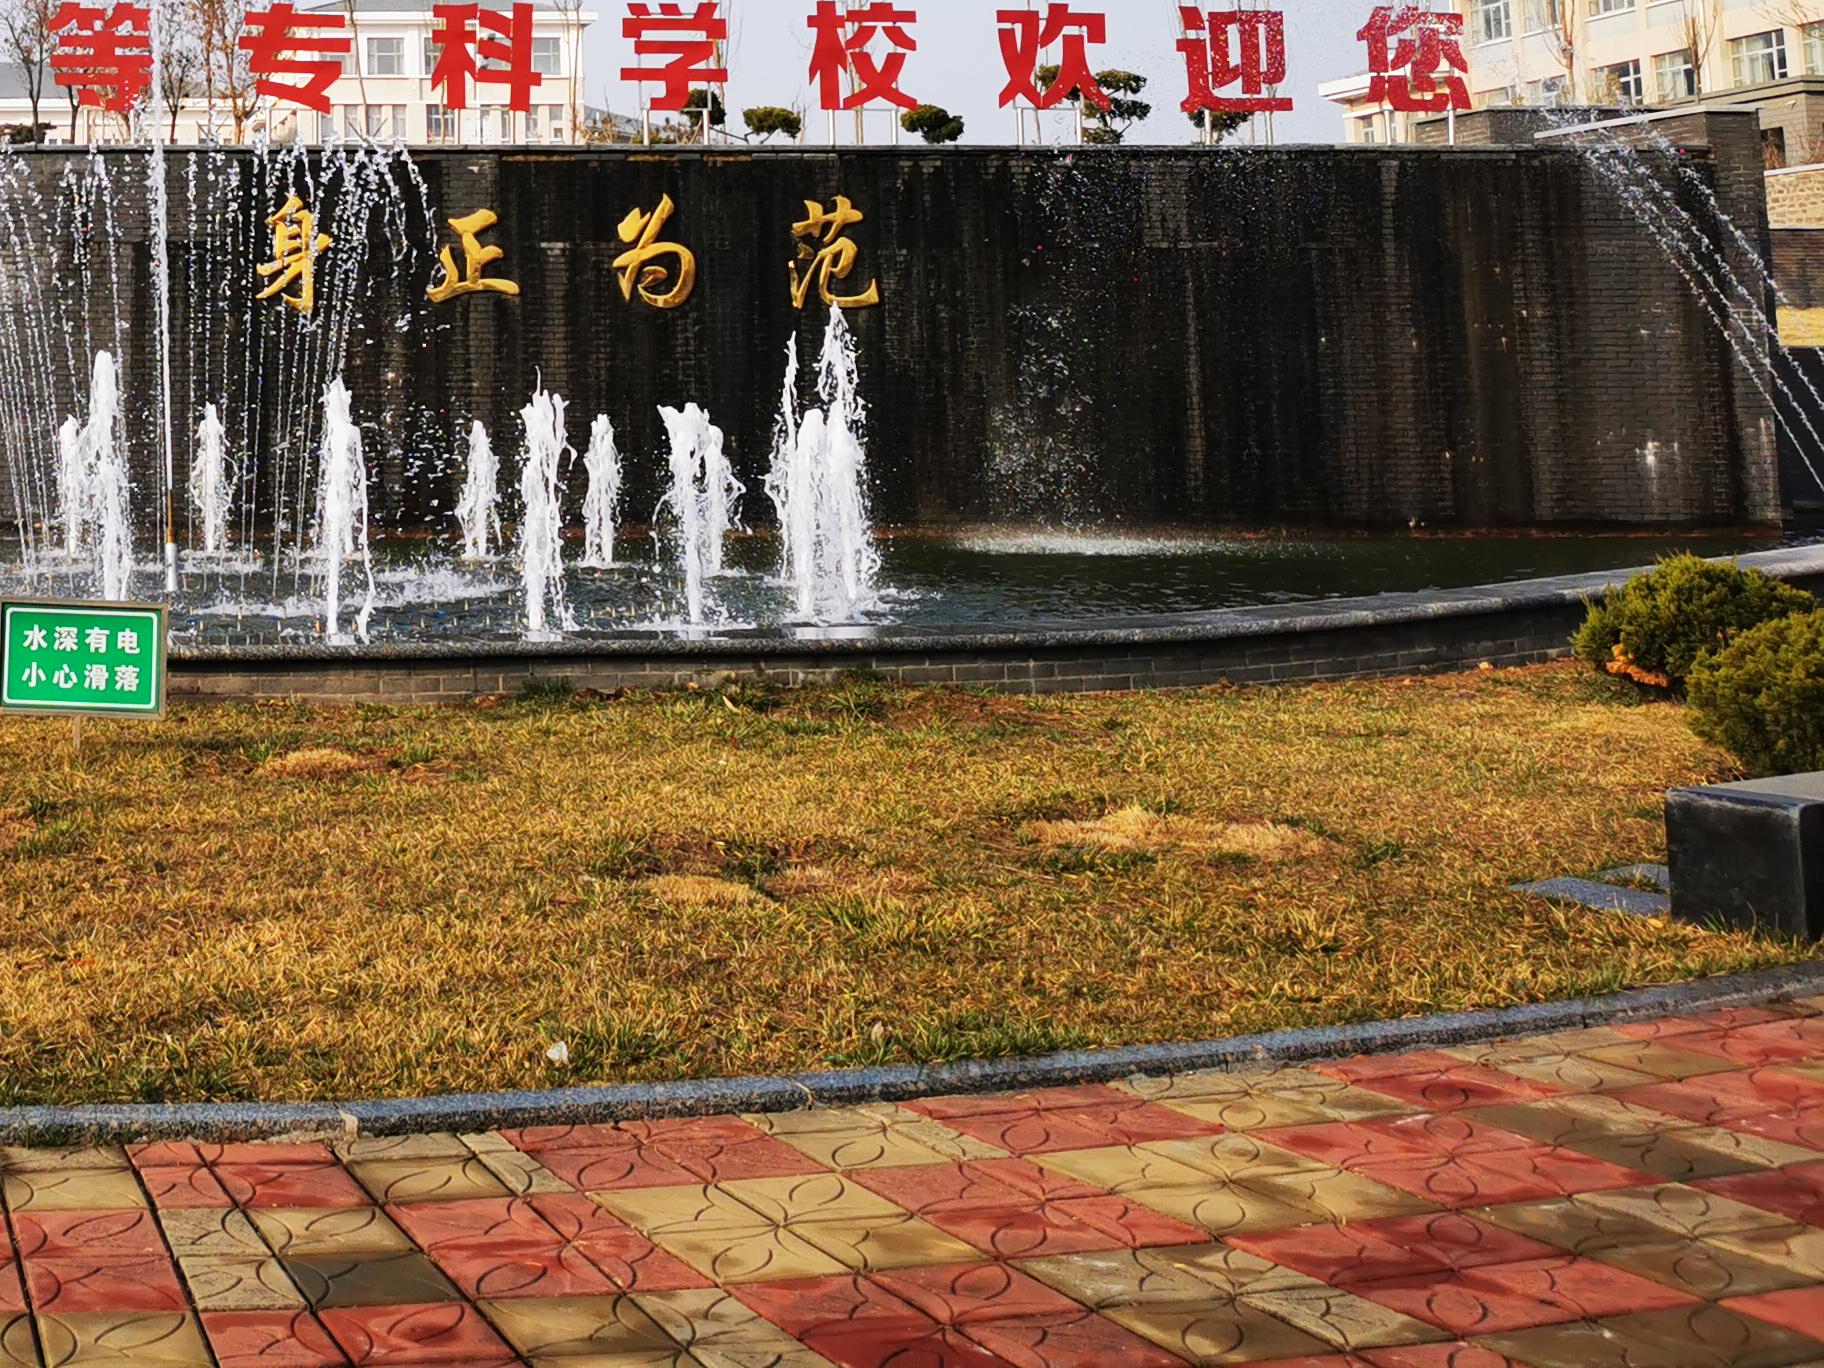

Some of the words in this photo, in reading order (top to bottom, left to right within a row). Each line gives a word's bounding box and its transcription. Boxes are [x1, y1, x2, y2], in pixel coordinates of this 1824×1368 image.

[256, 192, 880, 314] 身正为范
[23, 624, 141, 654] 水深有电
[21, 661, 140, 692] 小心滑落
